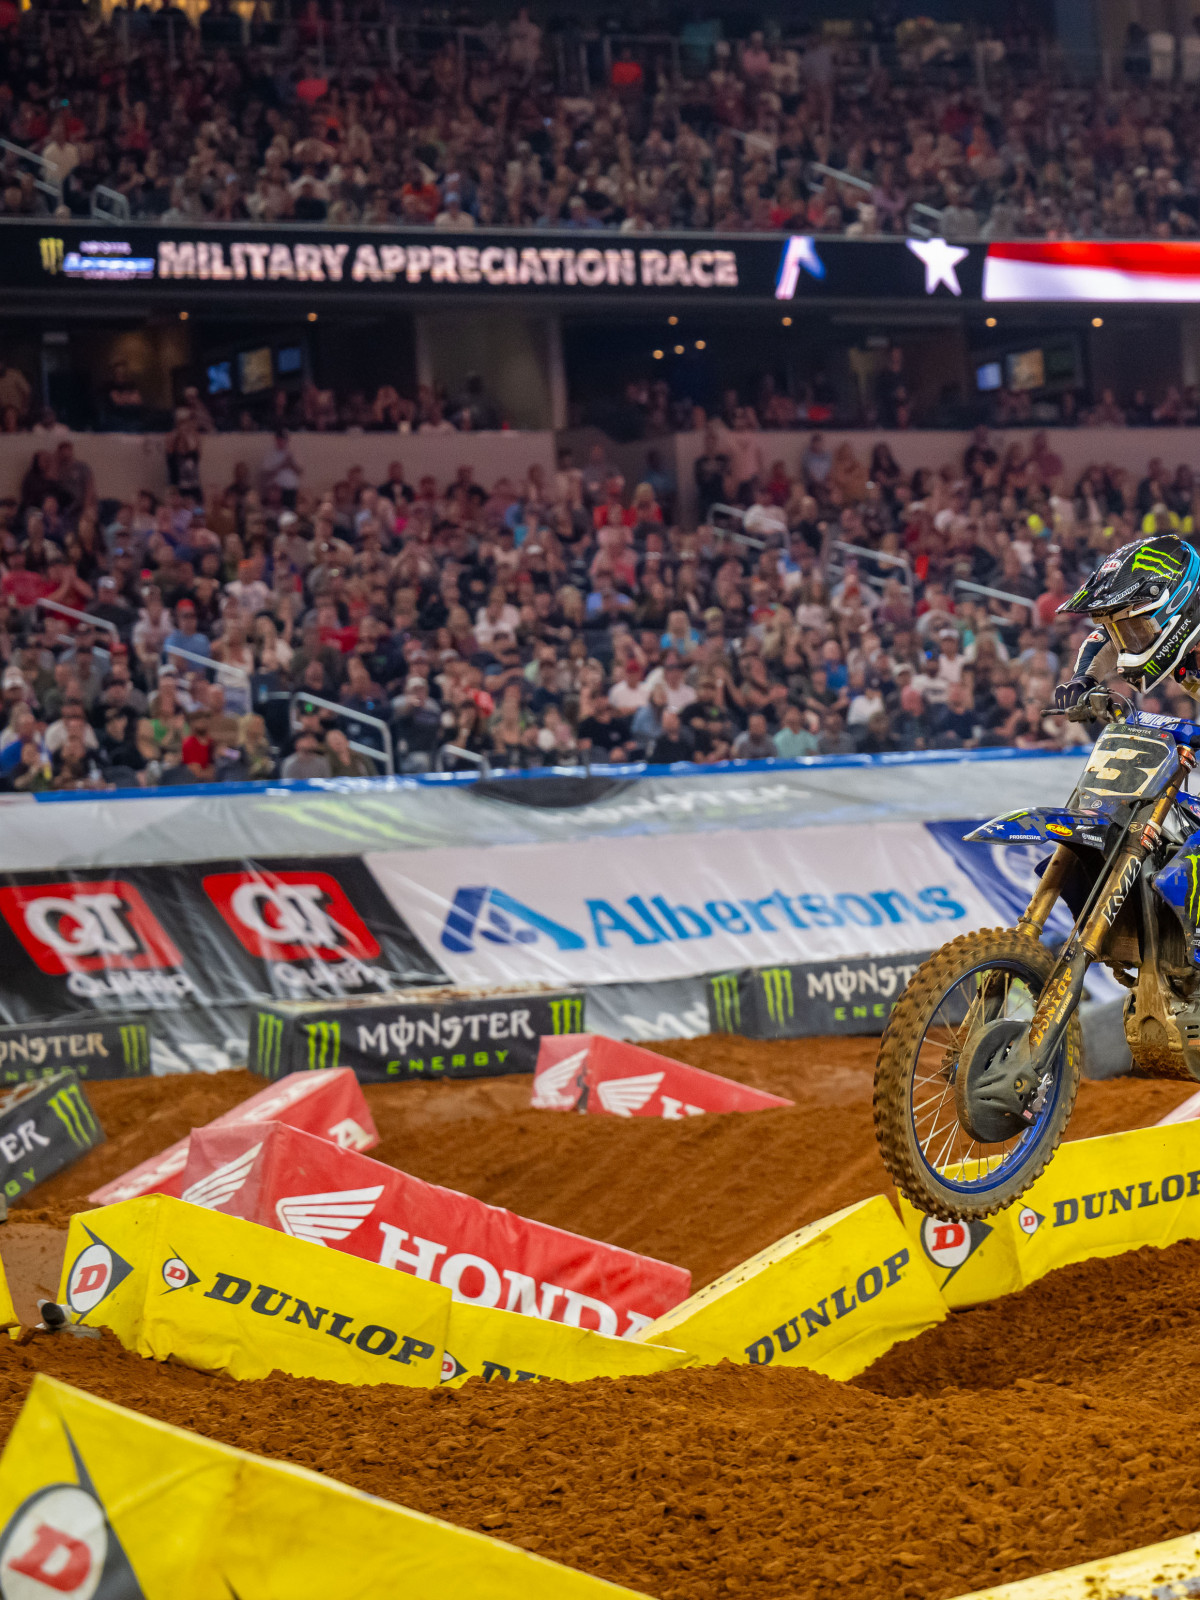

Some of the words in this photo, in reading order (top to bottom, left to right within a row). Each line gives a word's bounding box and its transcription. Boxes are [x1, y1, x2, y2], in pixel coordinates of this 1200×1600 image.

[158, 241, 349, 281] MILITARY
[352, 244, 636, 287] APPRECIATION
[641, 249, 739, 288] RACE
[1156, 618, 1192, 661] MONSTER
[1083, 737, 1170, 794] 3
[24, 893, 138, 956] QT
[230, 881, 337, 950] QT
[584, 885, 968, 948] Albertsons
[806, 962, 917, 1002] MONST
[358, 1010, 535, 1057] MONSTER
[387, 1050, 509, 1076] ENERGY
[931, 1221, 966, 1251] D
[1021, 1214, 1035, 1227] D
[73, 1263, 107, 1295] D
[166, 1265, 187, 1282] D
[203, 1272, 435, 1367] DUNLOP
[744, 1248, 910, 1366] DUNLOP
[8, 1523, 92, 1593] D
